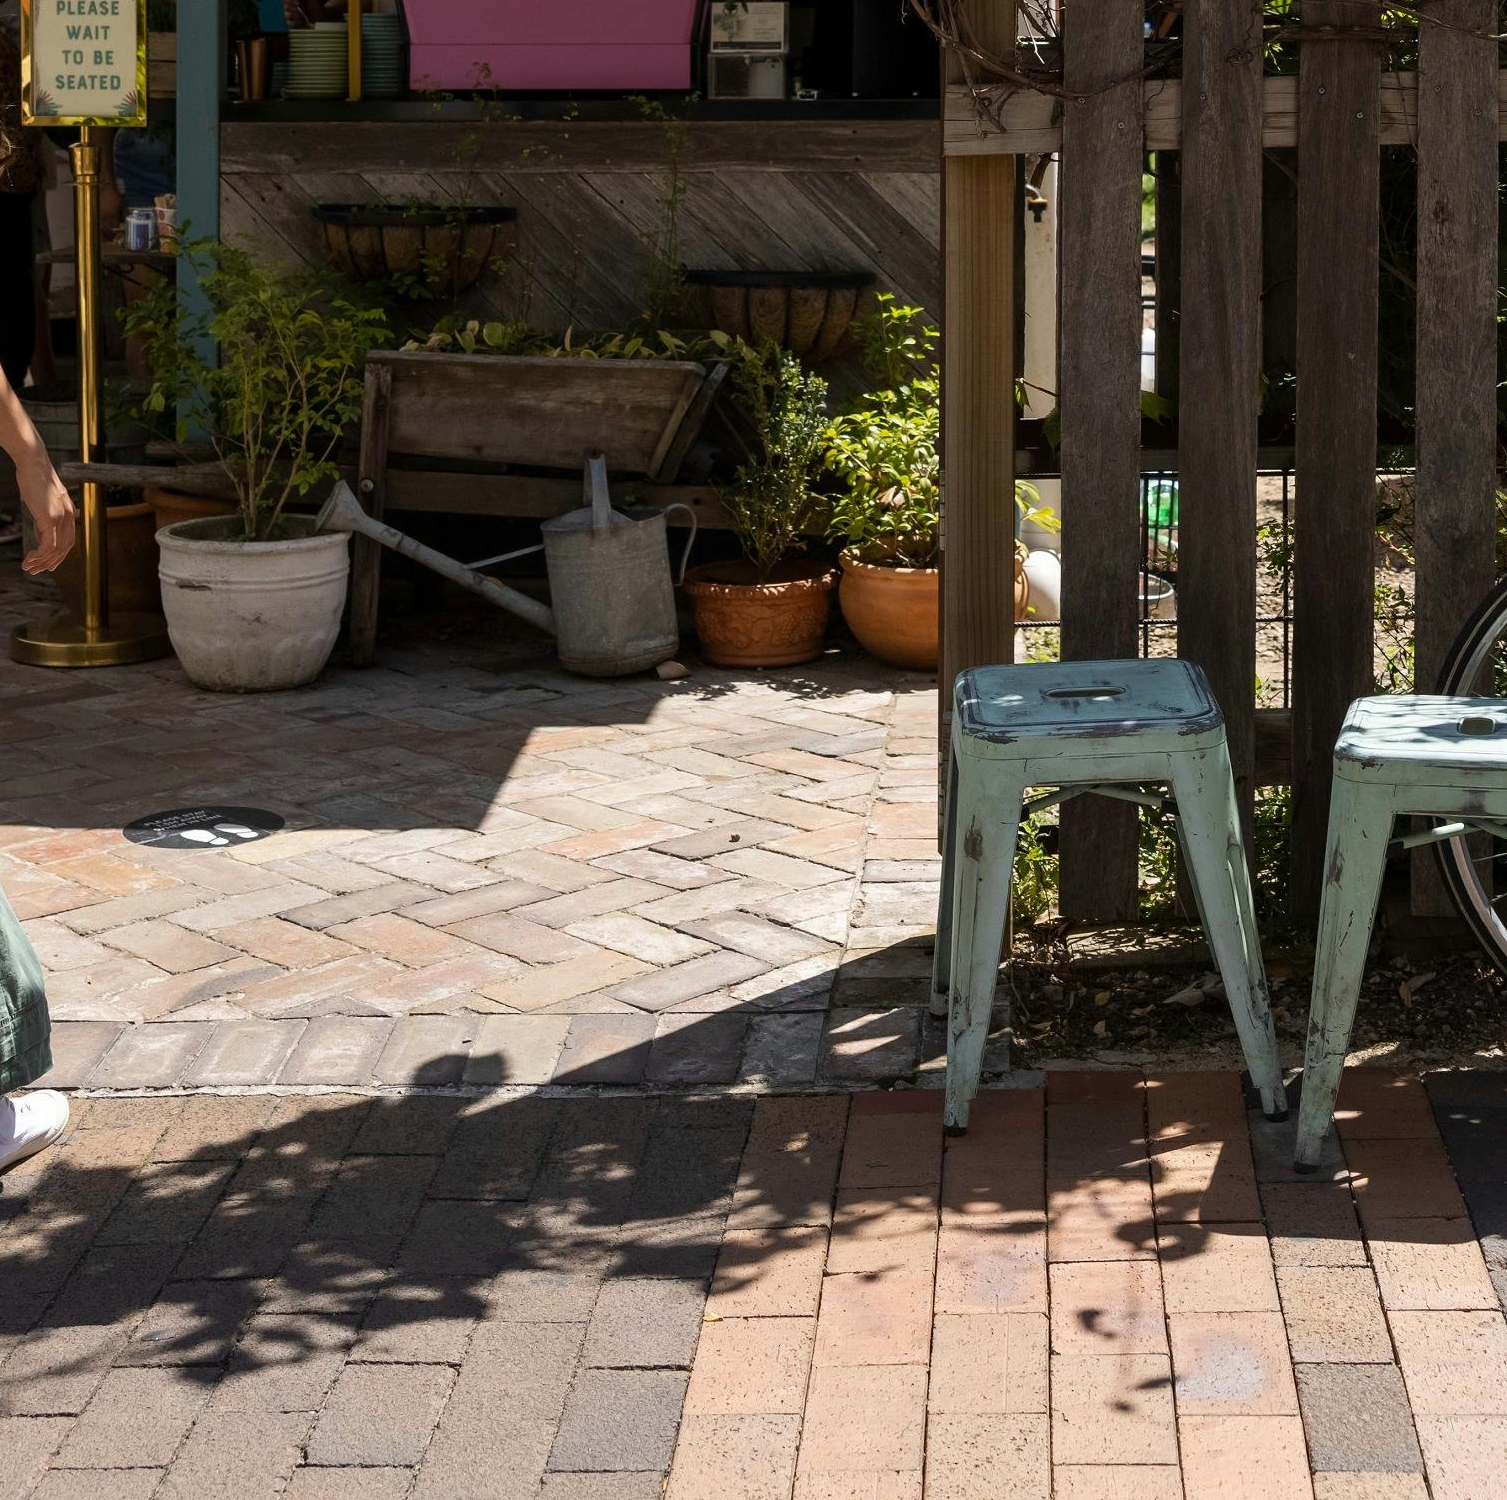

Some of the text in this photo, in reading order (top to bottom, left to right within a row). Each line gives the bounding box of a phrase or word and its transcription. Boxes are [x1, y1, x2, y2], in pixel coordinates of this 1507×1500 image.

[56, 0, 120, 16] PLEASE
[66, 25, 111, 41] WAIT
[61, 50, 114, 65] TO BE
[55, 74, 121, 90] SEATED
